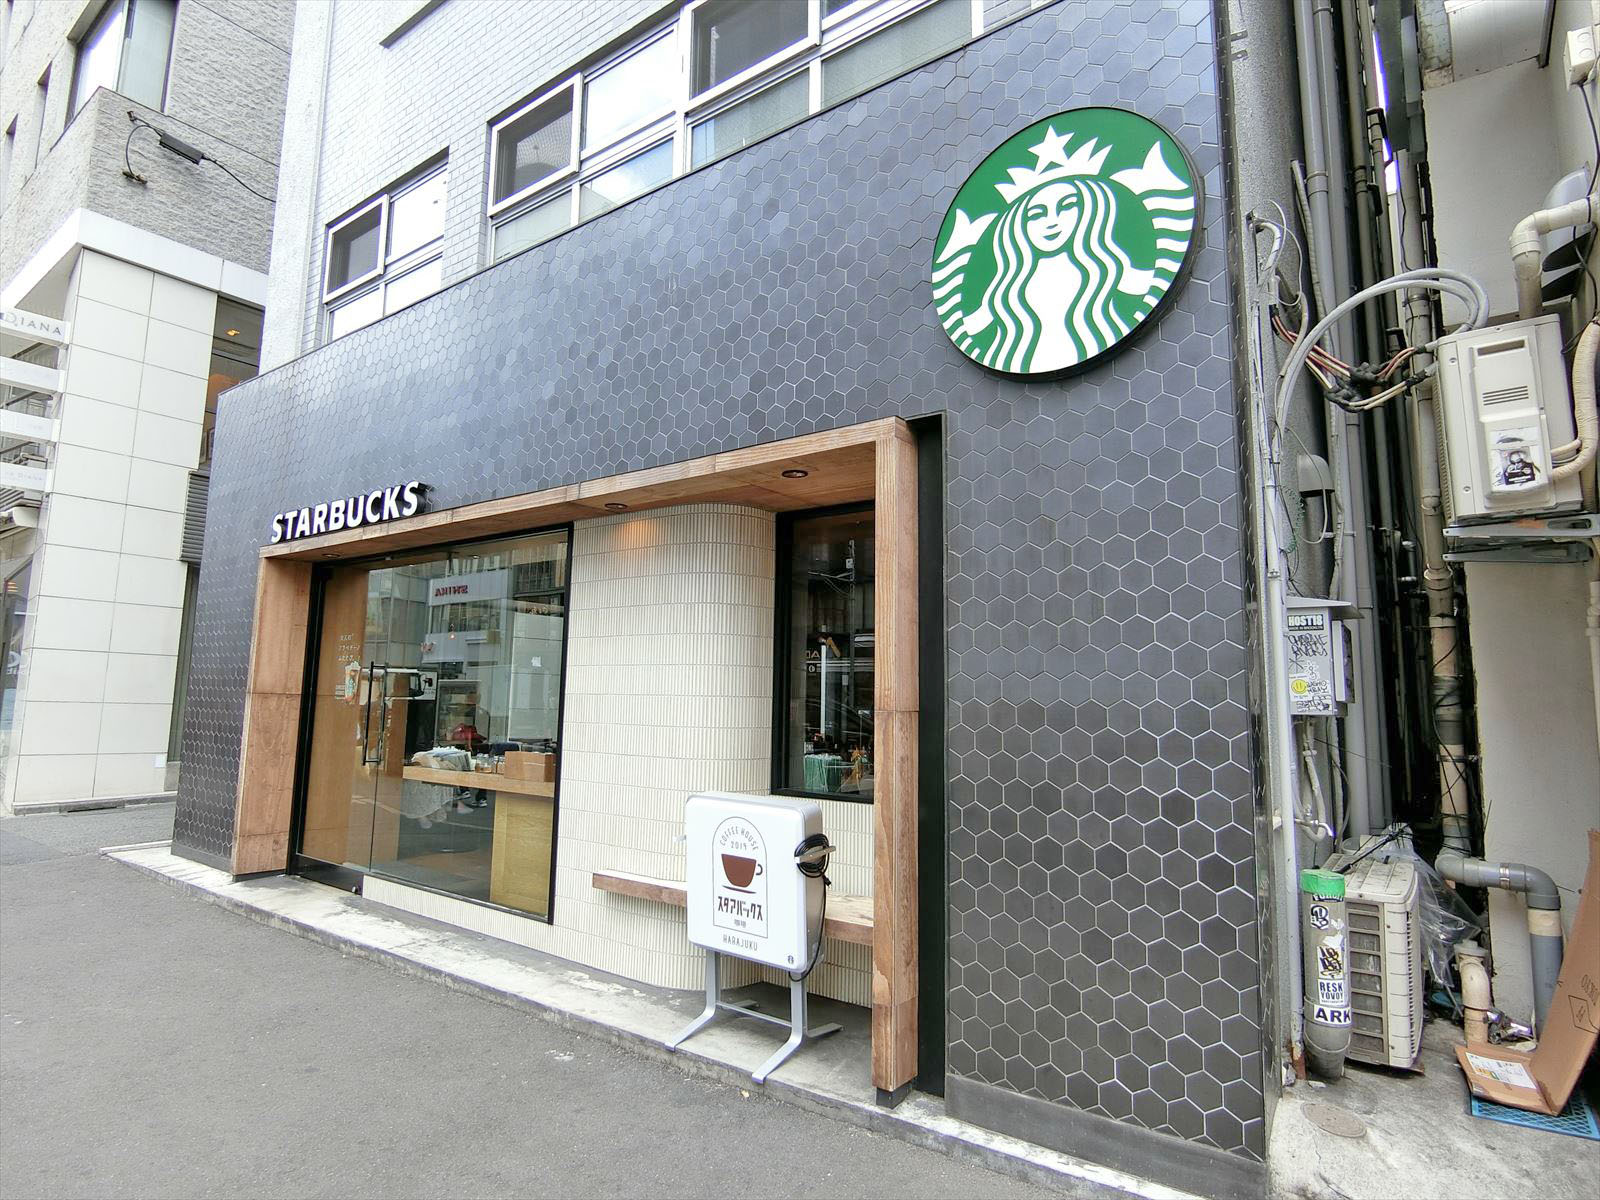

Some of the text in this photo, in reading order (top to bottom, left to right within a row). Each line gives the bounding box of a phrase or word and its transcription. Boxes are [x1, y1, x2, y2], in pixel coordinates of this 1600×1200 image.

[4, 311, 62, 336] DIANA
[271, 481, 419, 544] STARBUCKS
[719, 826, 759, 850] COFFEE HOUSE
[730, 841, 747, 851] 2019
[717, 895, 764, 921] スタアバックス
[722, 933, 758, 951] HARAJUKU
[1319, 982, 1344, 992] RESK
[1315, 1007, 1351, 1023] ARK
